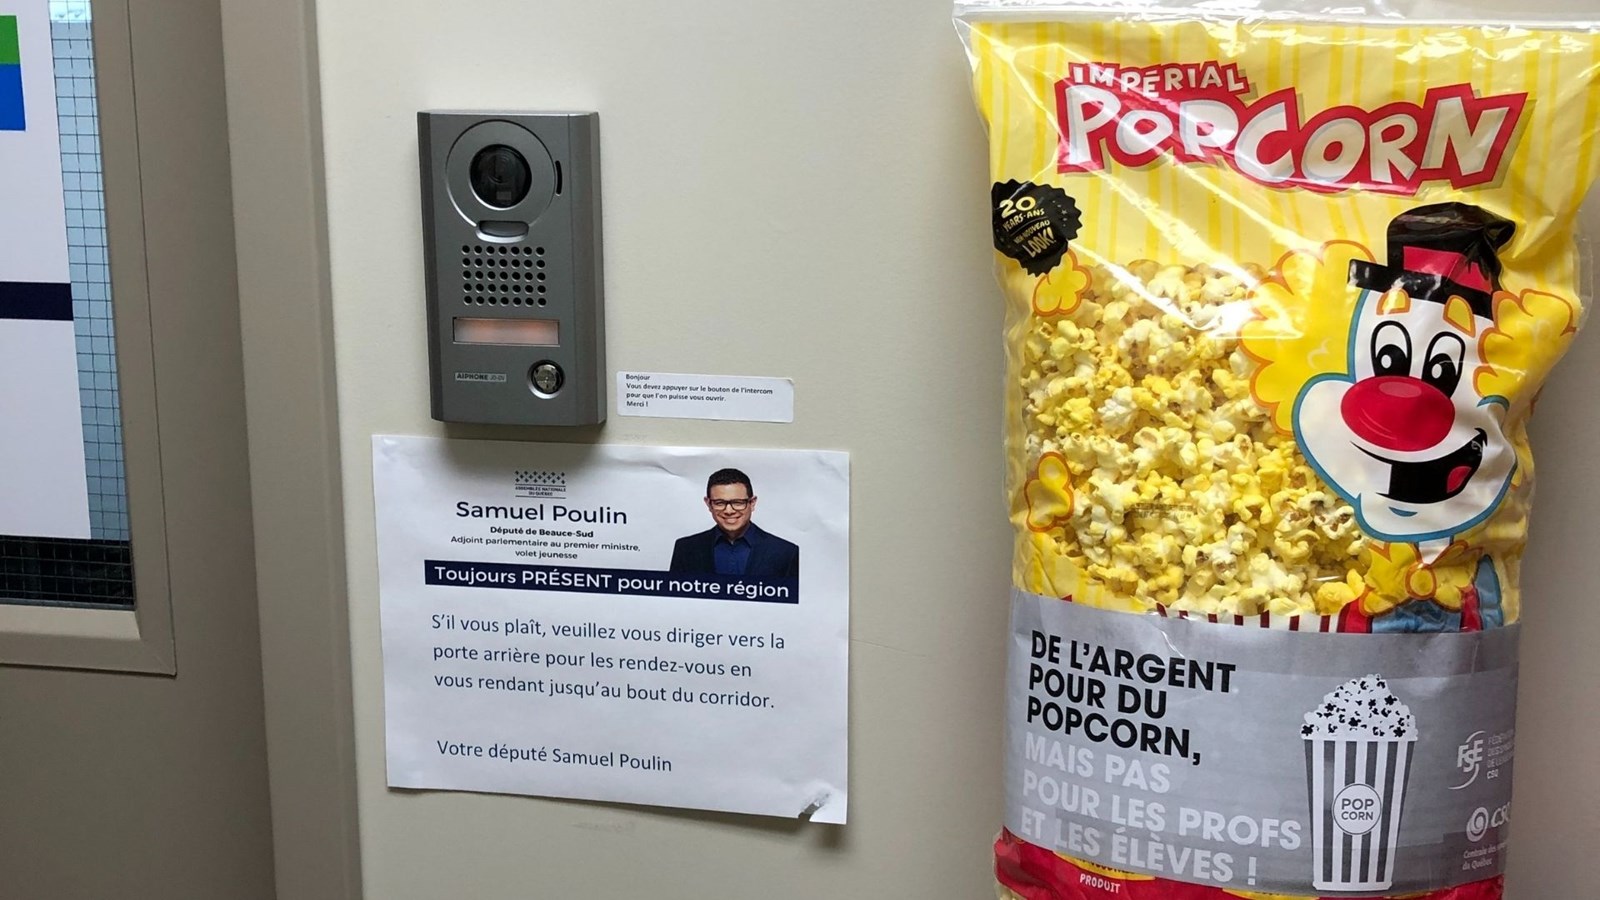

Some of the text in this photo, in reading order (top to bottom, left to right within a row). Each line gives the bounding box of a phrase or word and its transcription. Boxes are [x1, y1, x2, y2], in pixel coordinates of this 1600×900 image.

[1073, 66, 1245, 98] IMPÉRIAL
[1064, 83, 1510, 183] POPCORN
[1000, 196, 1036, 218] 20
[1022, 227, 1056, 257] LOOK!
[456, 501, 627, 525] Samuel Poulin
[450, 535, 483, 546] Adjoint
[485, 538, 548, 549] parlementaire
[564, 541, 599, 551] premier
[601, 542, 641, 552] ministre,
[490, 525, 594, 538] Député de Beauce-Sud
[538, 551, 578, 561] jeunesse
[434, 566, 789, 598] Toujours PRÉSENT pour notre région
[460, 619, 499, 633] vous
[504, 619, 547, 638] plaît,
[551, 622, 616, 639] veuillez
[621, 629, 662, 643] vous
[666, 628, 724, 648] diriger
[728, 634, 765, 648] vers
[770, 634, 785, 649] la
[433, 645, 752, 678] porte arrière pour les rendez-vous en
[1032, 631, 1236, 693] DE L'ARGENT
[434, 675, 775, 709] vous rendant jusqu'au bout du corridor.
[1029, 663, 1167, 719] POUR DU
[1026, 695, 1201, 766] POPCORN,
[437, 741, 672, 772] Votre député Samuel Poulin
[1025, 733, 1170, 793] MAIS PAS
[1023, 769, 1301, 850] POUR LES PROFS
[1341, 798, 1374, 810] POP
[1341, 810, 1374, 821] CORN
[1021, 806, 1046, 841] ET
[1053, 819, 1099, 858] LES
[1111, 831, 1235, 883] ÉLÈVES
[1246, 857, 1257, 885] !
[1080, 873, 1120, 894] PRODUIT
